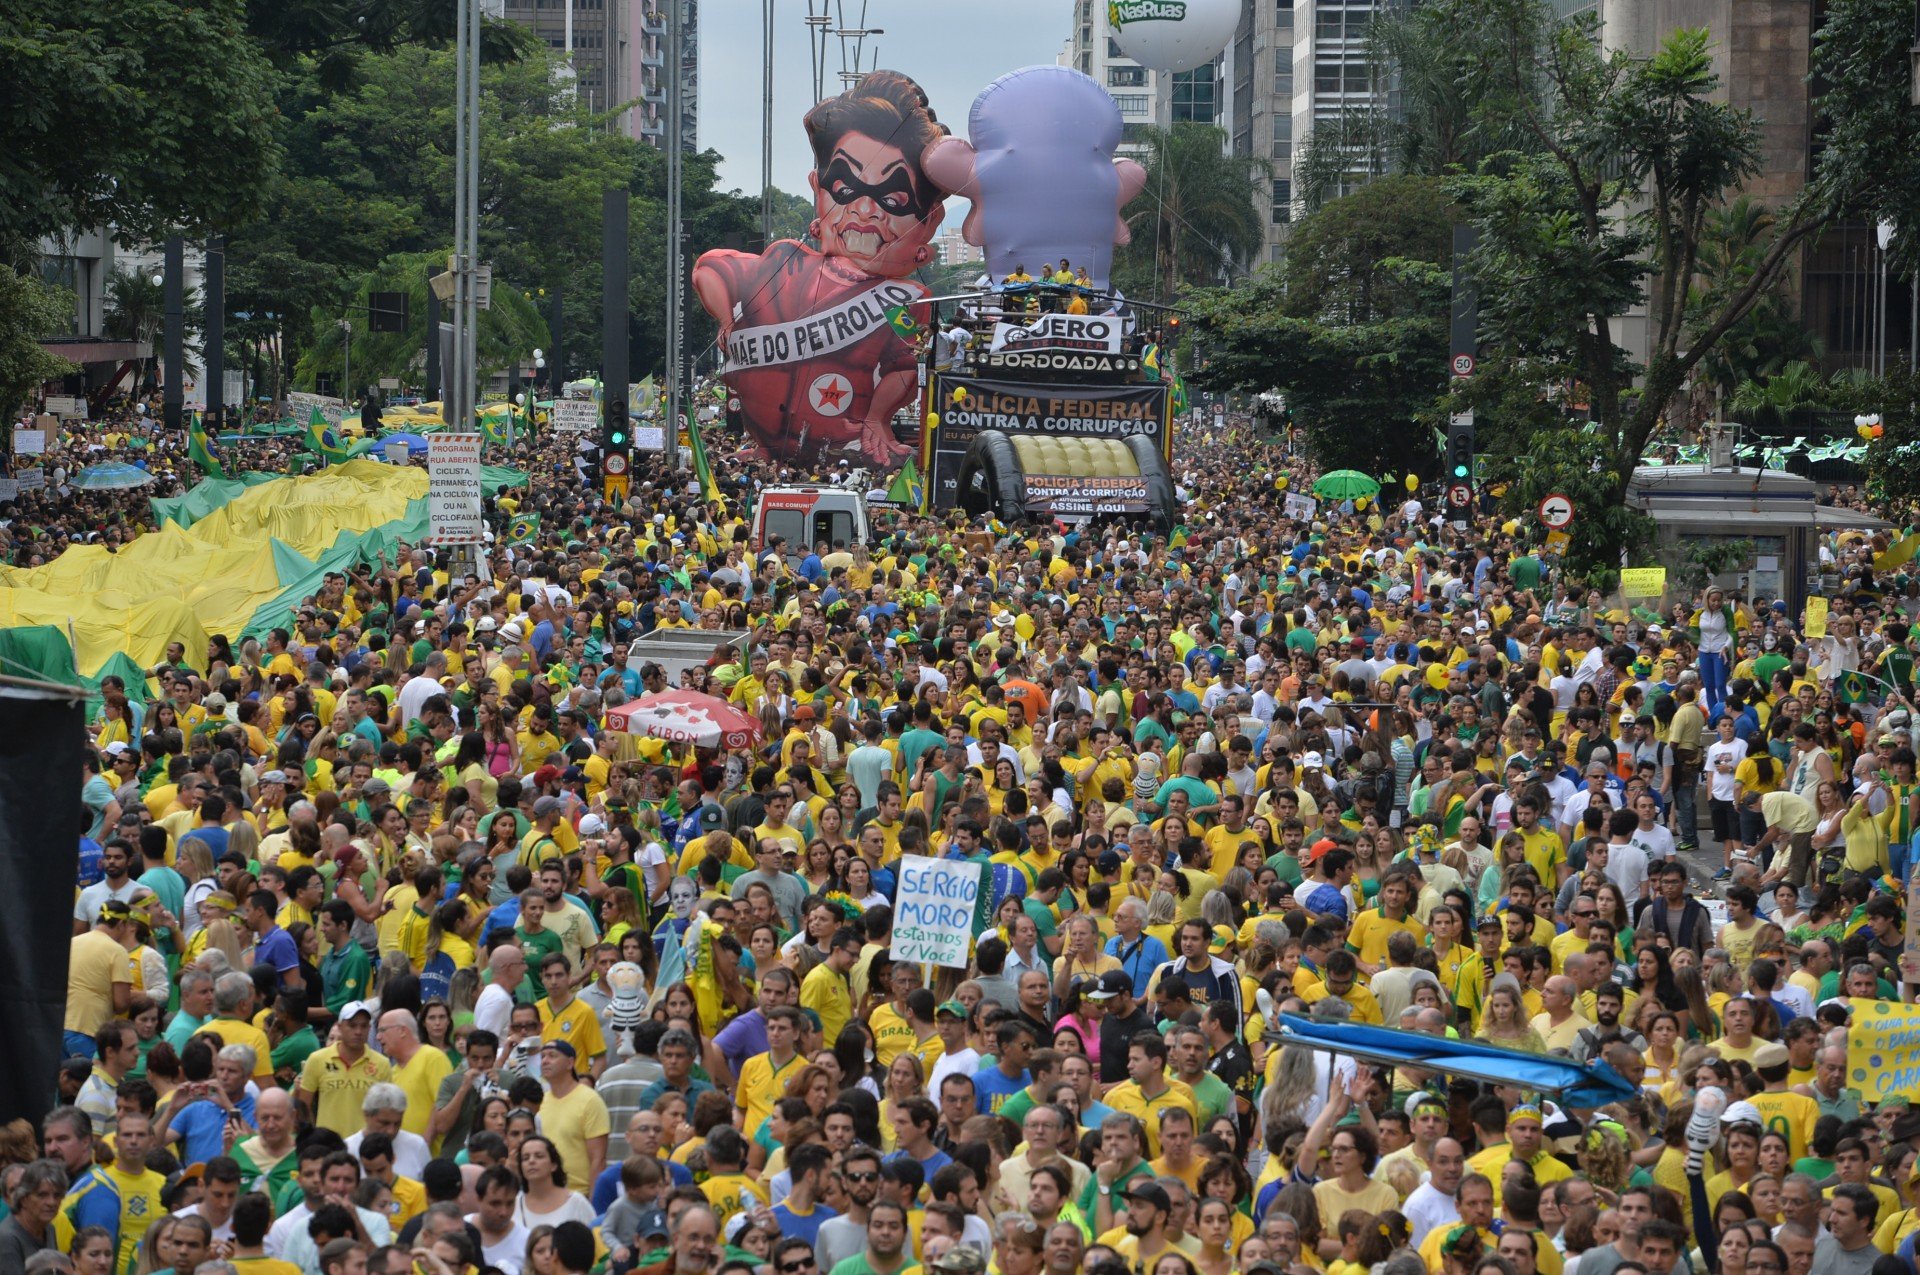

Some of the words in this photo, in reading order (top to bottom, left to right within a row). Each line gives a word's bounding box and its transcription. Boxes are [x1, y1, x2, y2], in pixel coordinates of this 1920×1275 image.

[730, 335, 759, 365] MÃE
[763, 331, 789, 363] DO
[794, 286, 912, 355] PETROLÃO
[1032, 338, 1104, 350] DEENDER
[990, 353, 1113, 371] BORDOADA
[1456, 359, 1471, 369] 50
[823, 390, 840, 400] 171
[1049, 398, 1158, 420] FEDERAL
[944, 411, 1021, 430] CONTRA
[1025, 416, 1039, 430] A
[1043, 417, 1158, 436] CORRUPÇÃO
[430, 480, 479, 488] PERMANEÇA
[944, 478, 958, 489] TÔ
[1025, 475, 1081, 488] POLÍCIA
[1084, 478, 1146, 488] FEDERAL
[1026, 487, 1070, 496] CONTRA
[1071, 488, 1080, 496] A
[1082, 487, 1146, 498] CORRUPÇÃO
[1050, 502, 1094, 511] ASSINE
[1096, 504, 1126, 512] AQUI
[647, 724, 699, 743] KIBON
[902, 866, 977, 902] SÉRGIO
[900, 901, 969, 929] MORO
[893, 926, 962, 947] estamos
